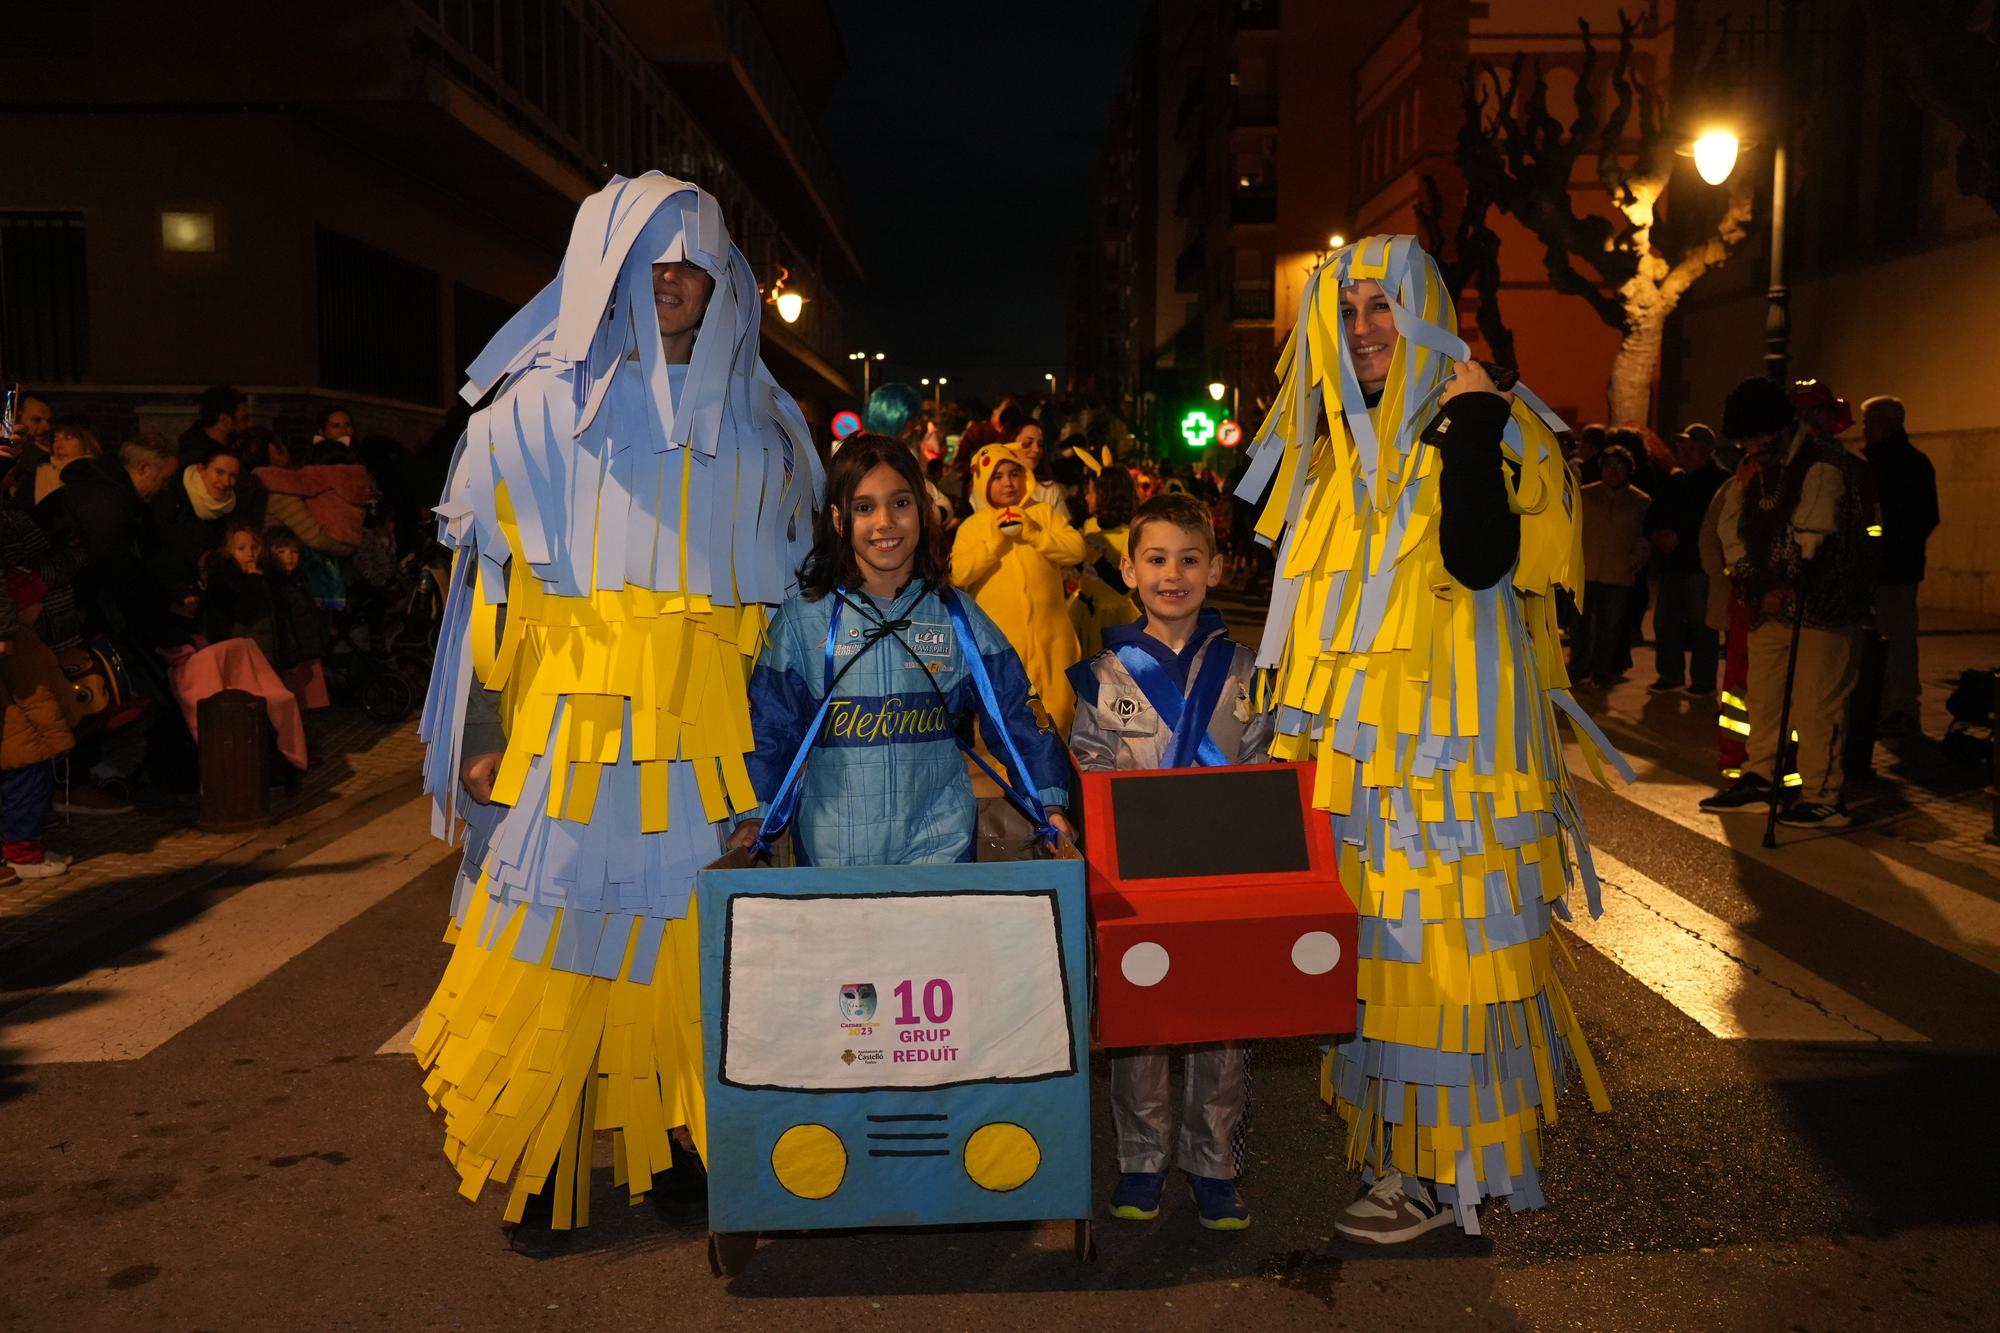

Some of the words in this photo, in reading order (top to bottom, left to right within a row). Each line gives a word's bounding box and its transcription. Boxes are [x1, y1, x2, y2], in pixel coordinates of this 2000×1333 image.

[894, 978, 953, 1025] 10
[848, 1027, 873, 1036] 2023
[899, 1029, 951, 1043] GRUP
[893, 1045, 959, 1063] REDUÏT
